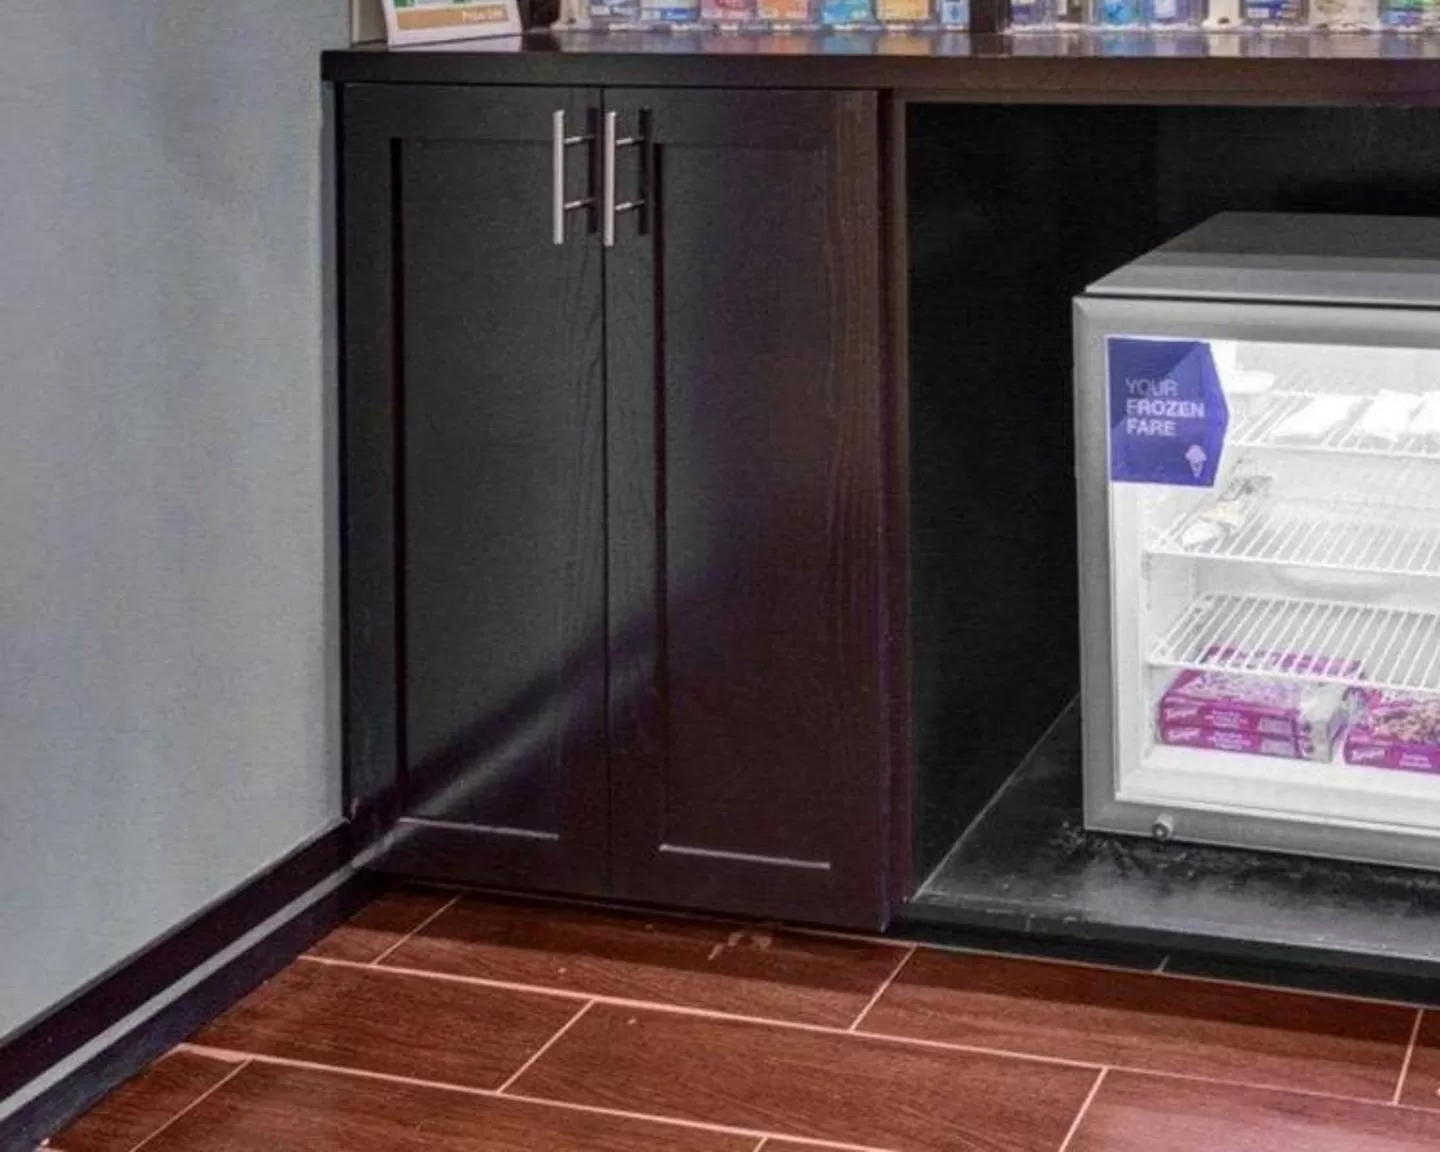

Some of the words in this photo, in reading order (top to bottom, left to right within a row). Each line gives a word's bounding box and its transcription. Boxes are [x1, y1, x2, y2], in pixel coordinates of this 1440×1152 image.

[1125, 377, 1178, 397] YOUR
[1126, 398, 1206, 419] FROZEN
[1126, 418, 1177, 438] FARE
